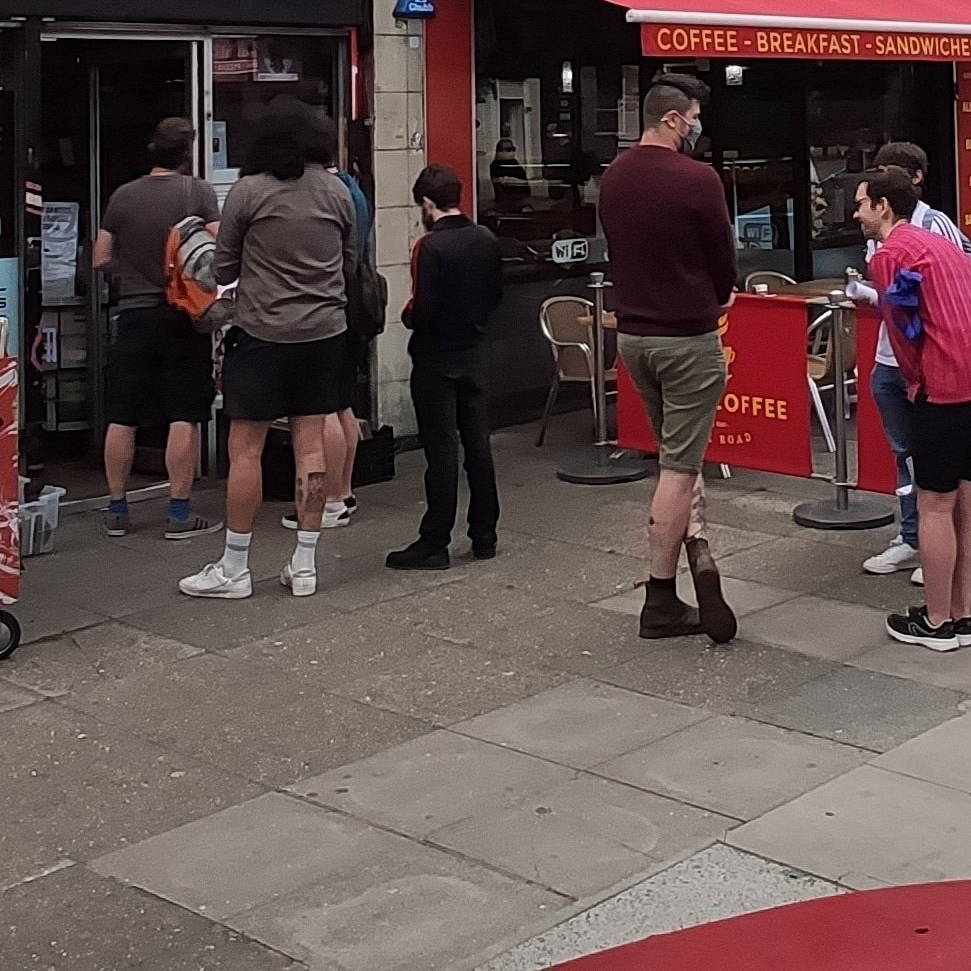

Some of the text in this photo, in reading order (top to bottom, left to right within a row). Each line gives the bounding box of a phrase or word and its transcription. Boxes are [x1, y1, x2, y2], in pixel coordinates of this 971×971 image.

[657, 27, 739, 52] COFFEE
[757, 31, 861, 55] BREAKFAST
[716, 393, 788, 420] OFFEE
